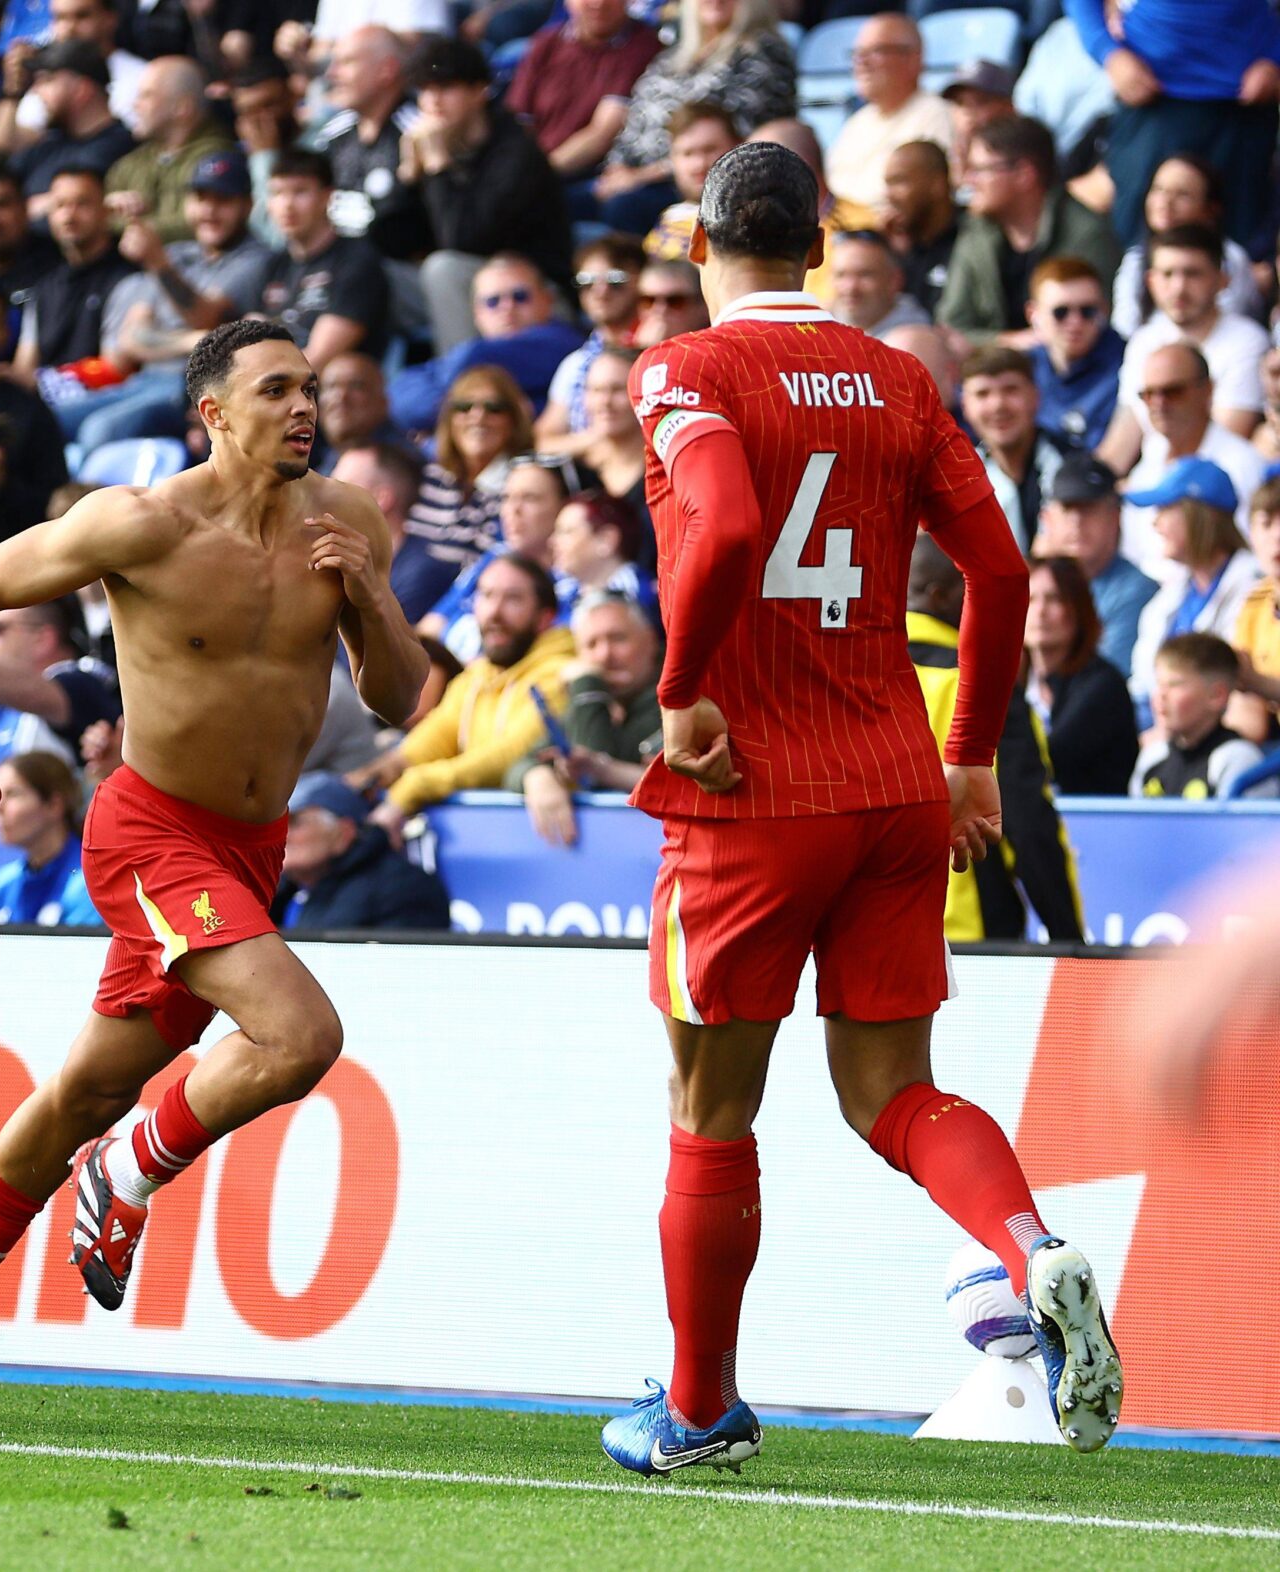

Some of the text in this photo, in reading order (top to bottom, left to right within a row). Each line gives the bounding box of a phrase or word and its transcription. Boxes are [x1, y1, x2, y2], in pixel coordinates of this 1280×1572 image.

[778, 371, 885, 407] VIRGIL
[761, 452, 863, 629] 4
[742, 1201, 760, 1219] LF
